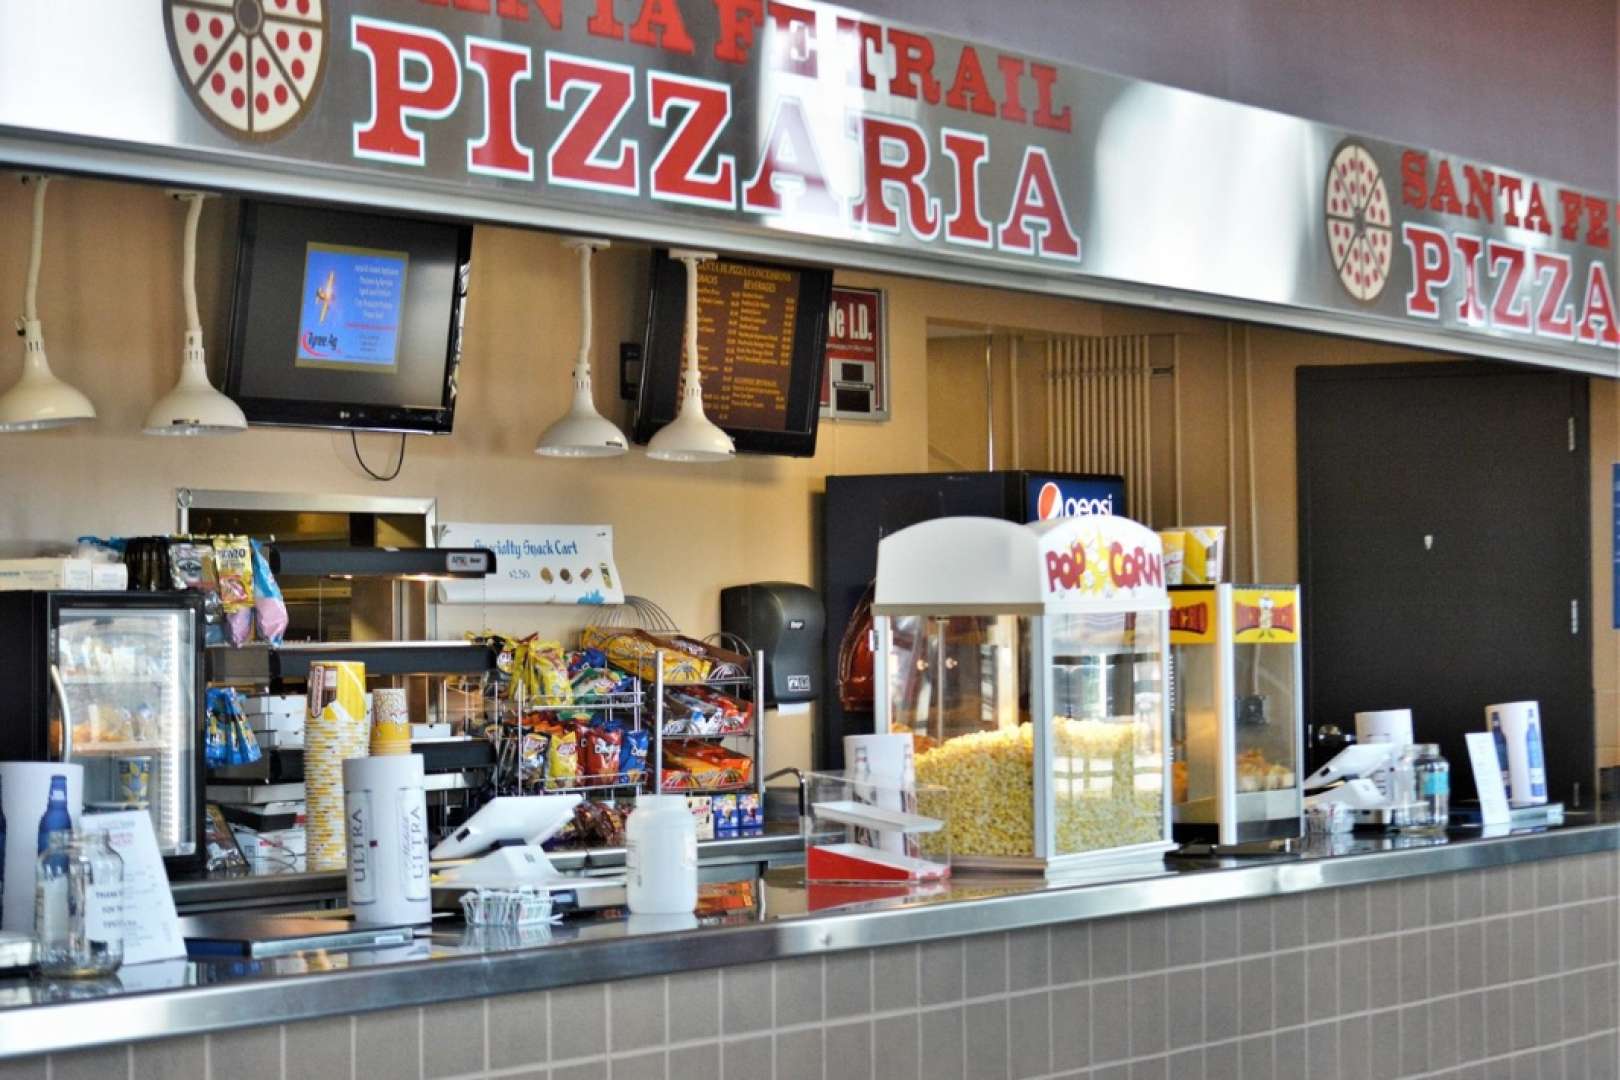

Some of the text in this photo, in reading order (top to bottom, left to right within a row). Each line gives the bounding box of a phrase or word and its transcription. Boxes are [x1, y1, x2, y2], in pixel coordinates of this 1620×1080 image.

[836, 17, 1072, 134] TRAIL
[351, 15, 1082, 263] PIZZARIA
[1402, 149, 1613, 249] SANTA FE
[555, 540, 578, 555] Cart
[1046, 541, 1162, 593] POP CORN
[352, 809, 365, 882] ULTRA
[410, 806, 423, 879] ULTRA
